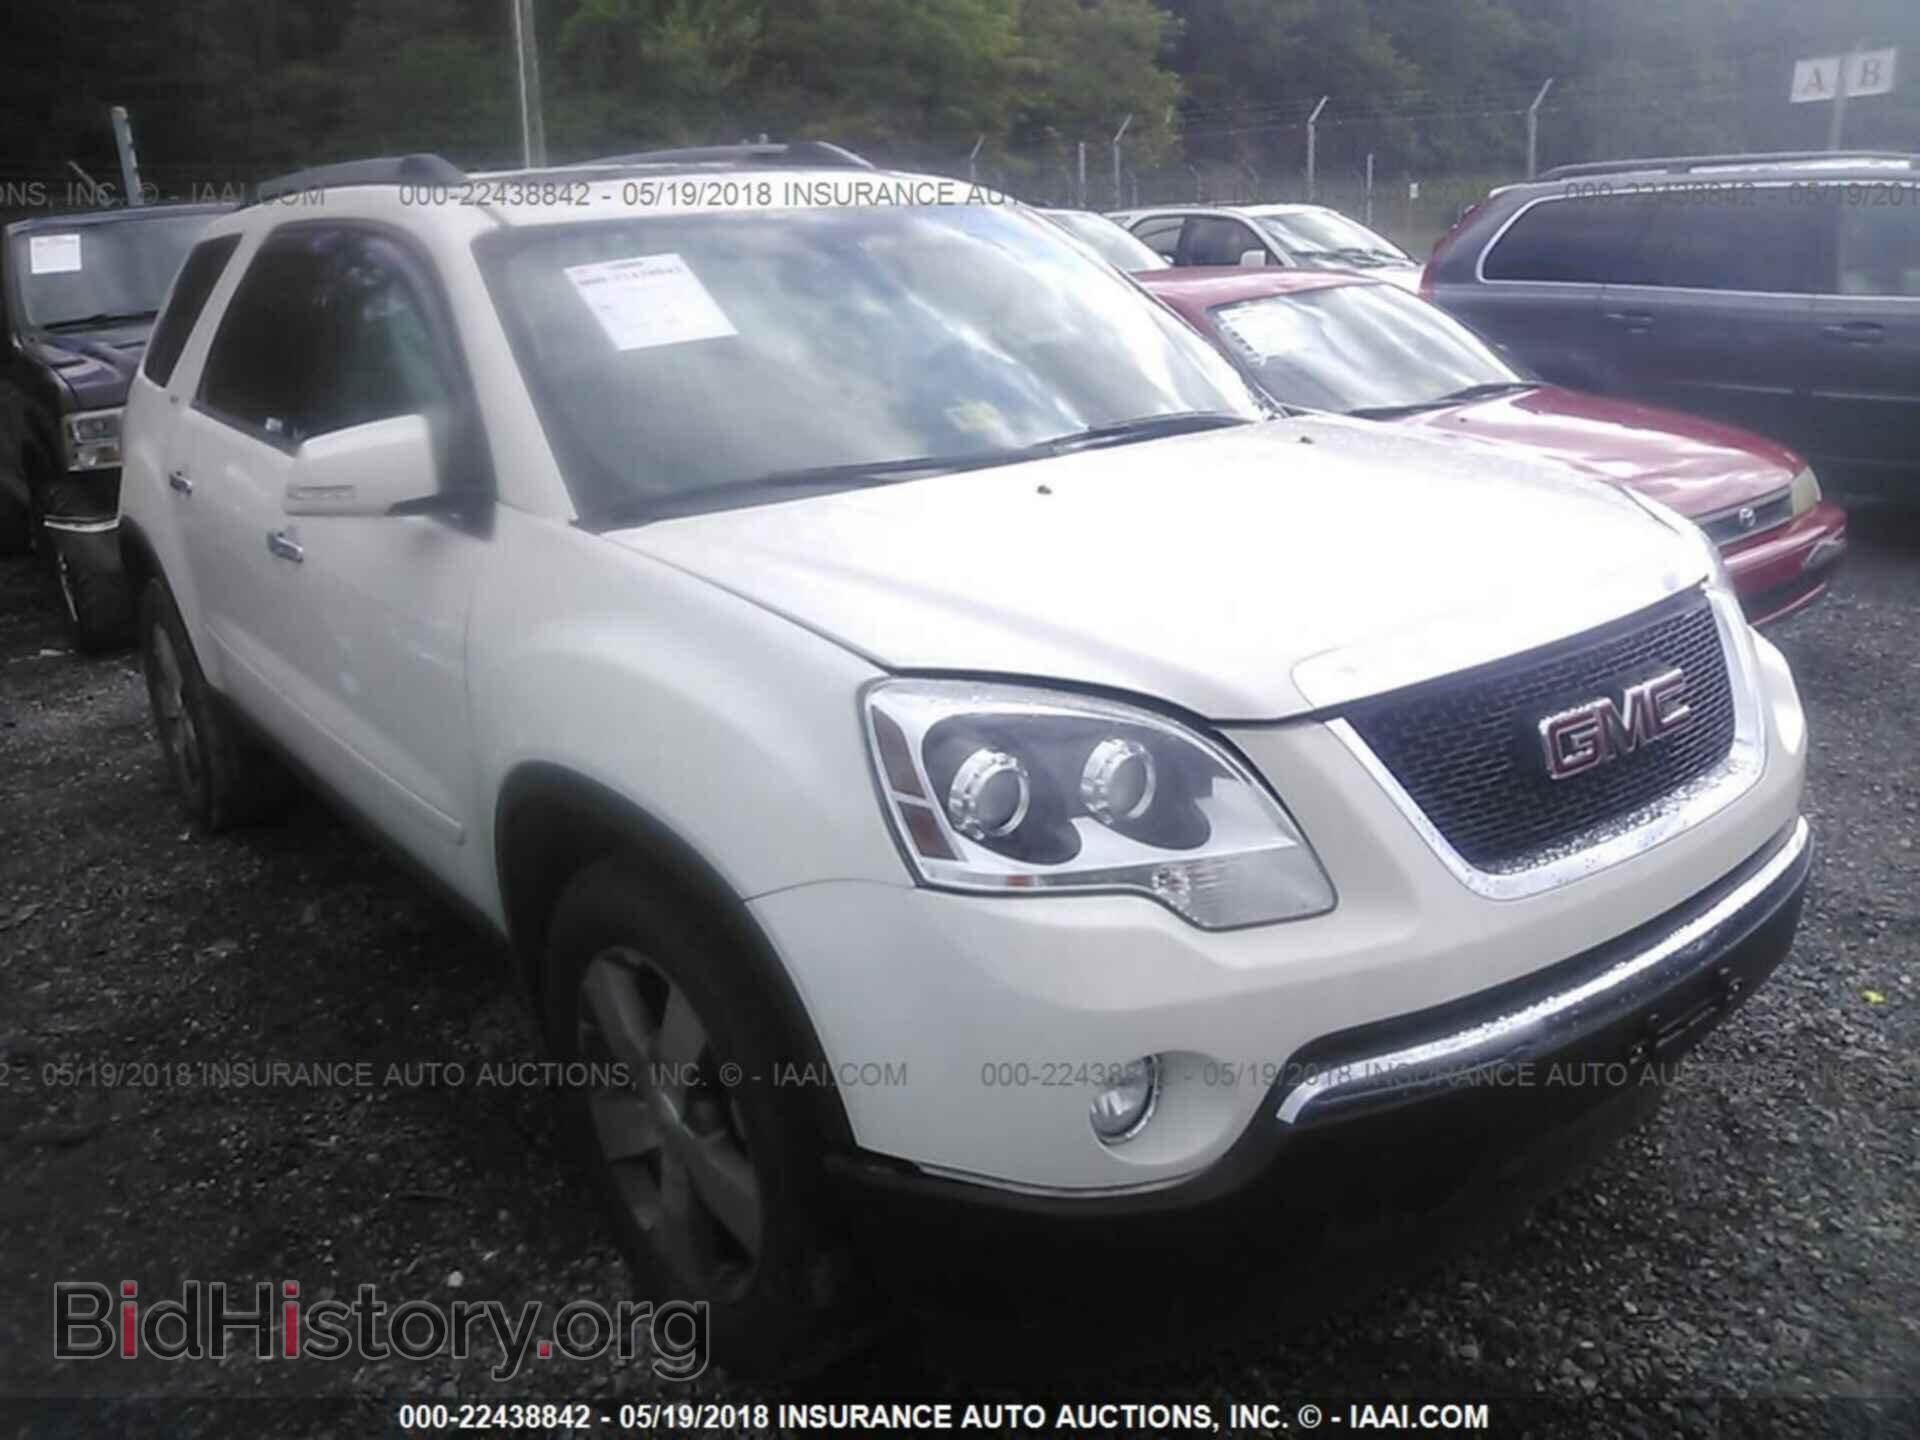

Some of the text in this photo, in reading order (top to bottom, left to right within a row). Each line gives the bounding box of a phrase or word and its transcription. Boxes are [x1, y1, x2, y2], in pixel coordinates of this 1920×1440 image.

[1802, 66, 1825, 93] A
[1861, 60, 1880, 86] B
[1538, 668, 1694, 780] GMC
